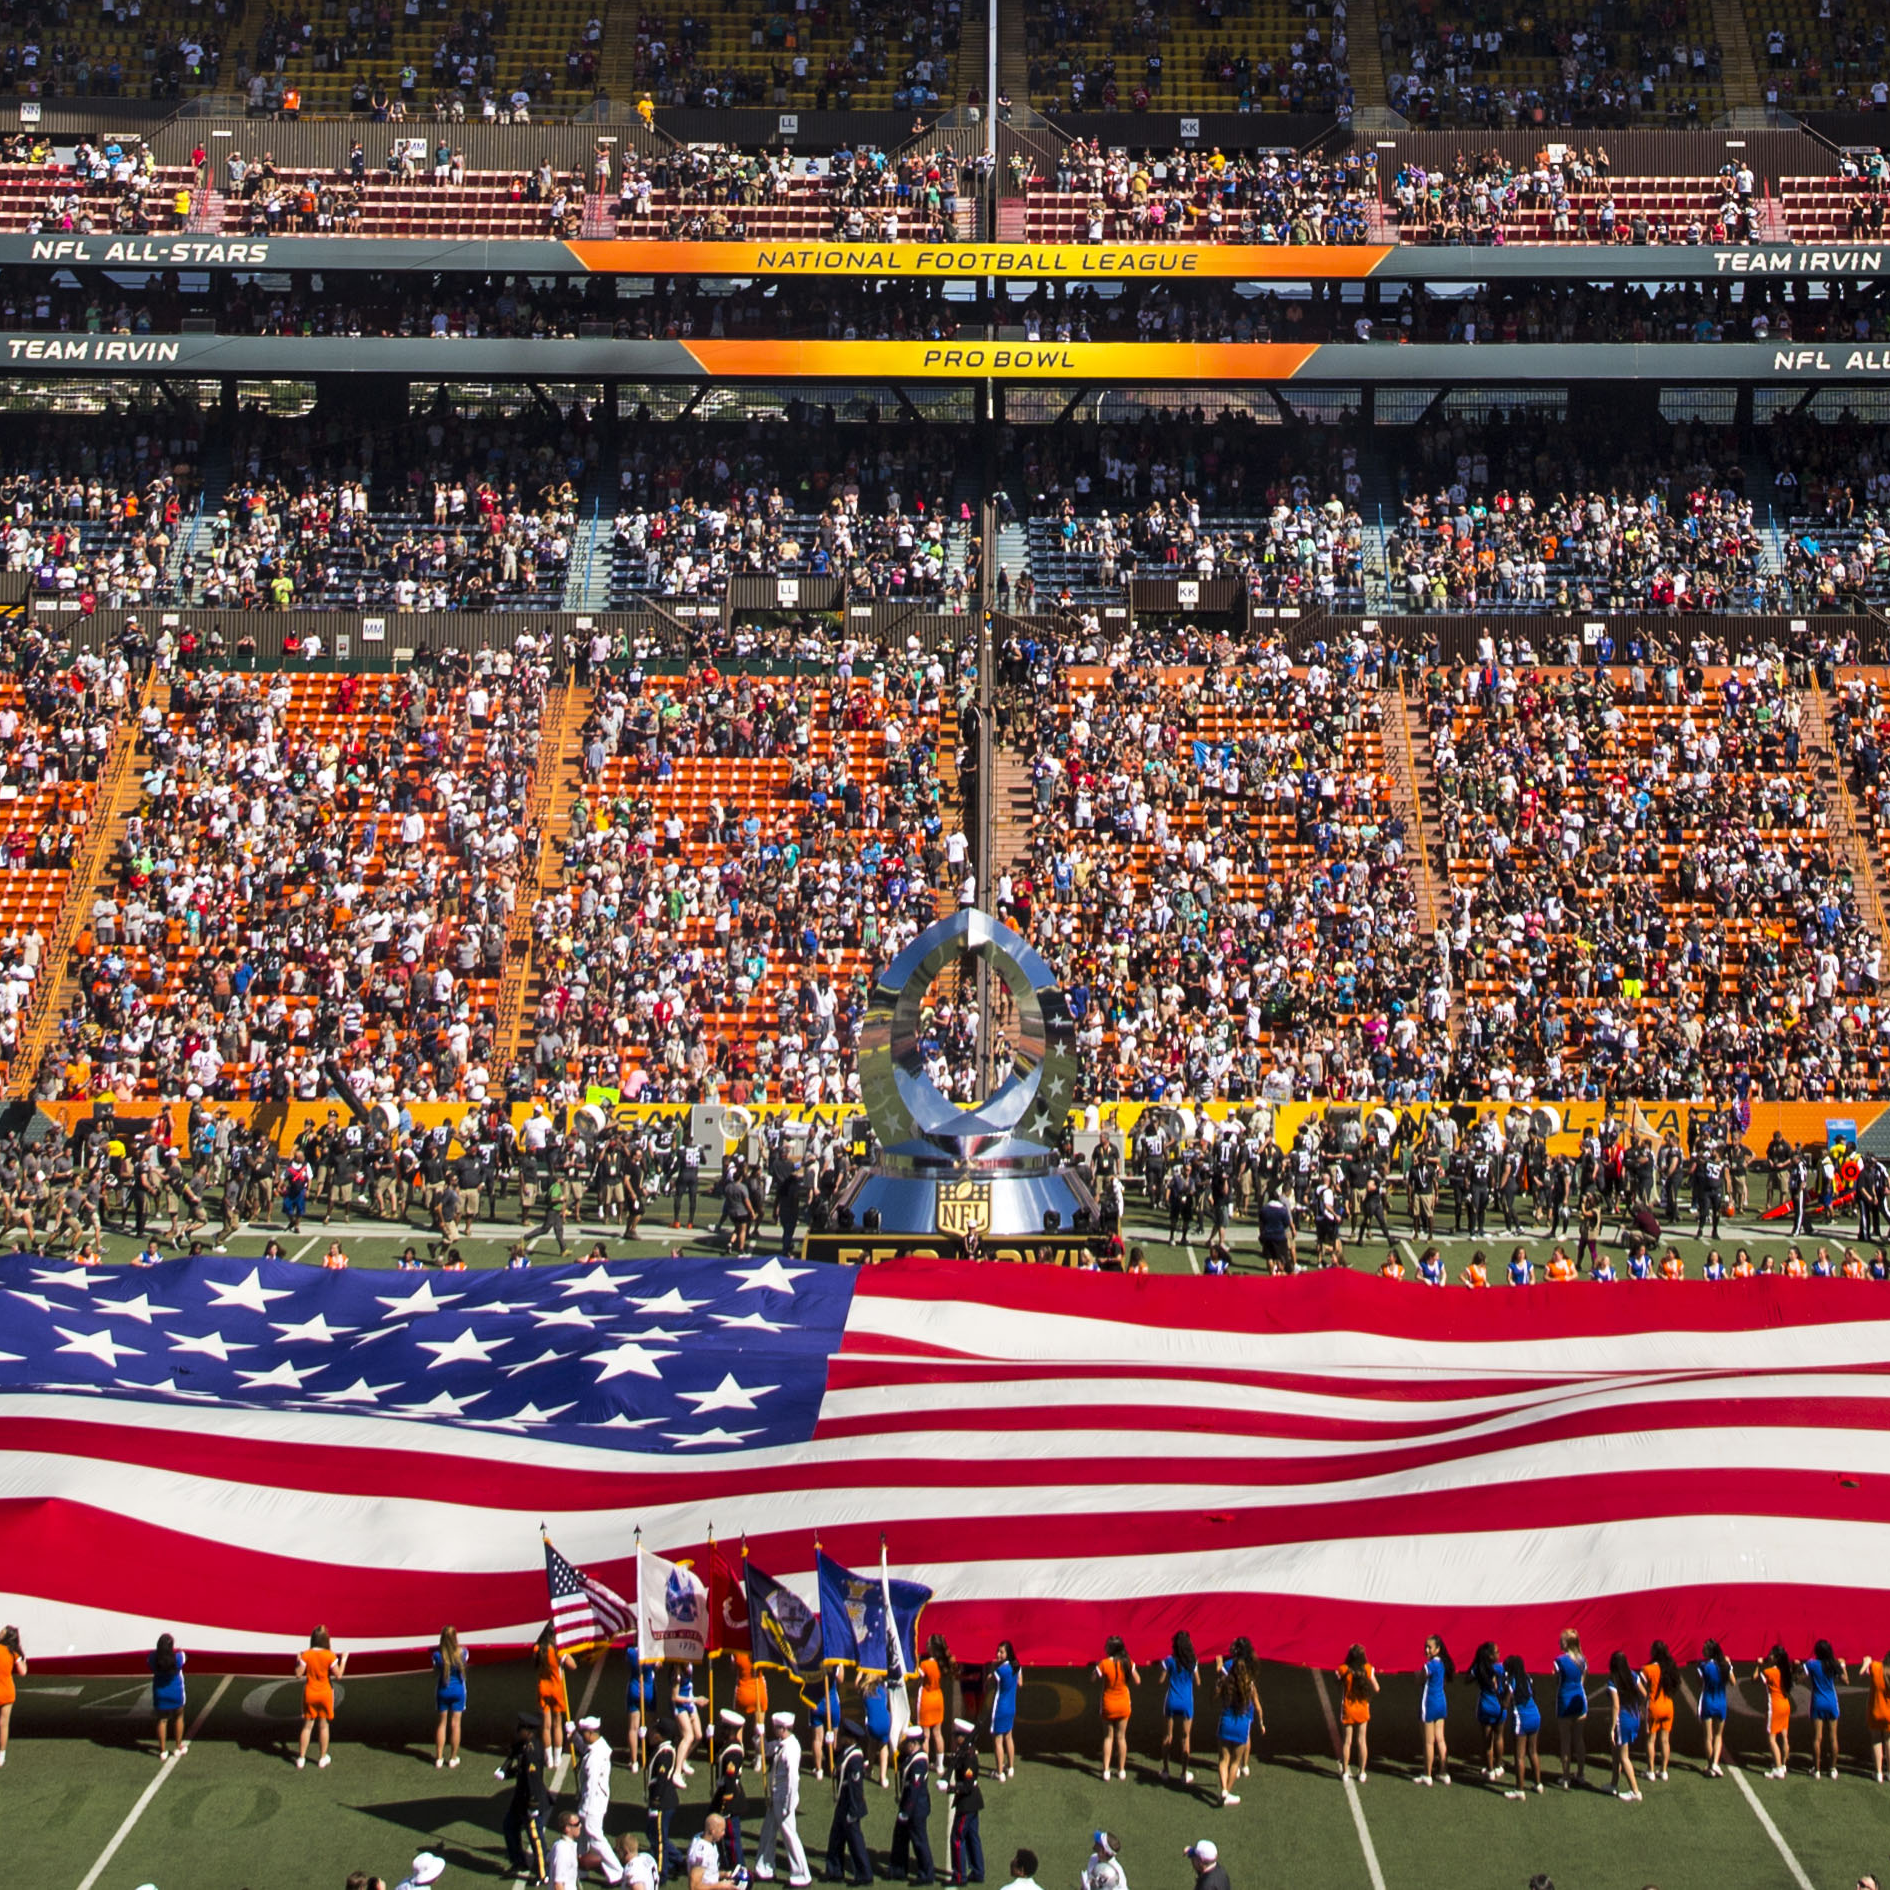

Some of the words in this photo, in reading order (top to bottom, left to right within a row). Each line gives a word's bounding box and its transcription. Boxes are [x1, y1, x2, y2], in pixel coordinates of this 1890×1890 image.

[782, 118, 794, 127] LL
[1180, 122, 1197, 132] KK
[31, 241, 91, 261] NFL
[104, 242, 269, 263] ALL-STARS
[757, 251, 902, 270] NATIONAL
[916, 252, 1068, 271] FOOTBALL
[1081, 253, 1199, 272] LEAGUE
[1713, 252, 1796, 273] TEAM
[1799, 252, 1883, 272] IRVIN
[6, 340, 89, 360] TEAM
[94, 341, 179, 362] IRVIN
[923, 350, 985, 368] PRO
[993, 351, 1076, 369] BOWL
[1773, 351, 1831, 371] NFL
[780, 584, 794, 594] LL
[1179, 586, 1196, 597] KK
[364, 624, 383, 634] MM
[942, 1202, 988, 1232] NFL
